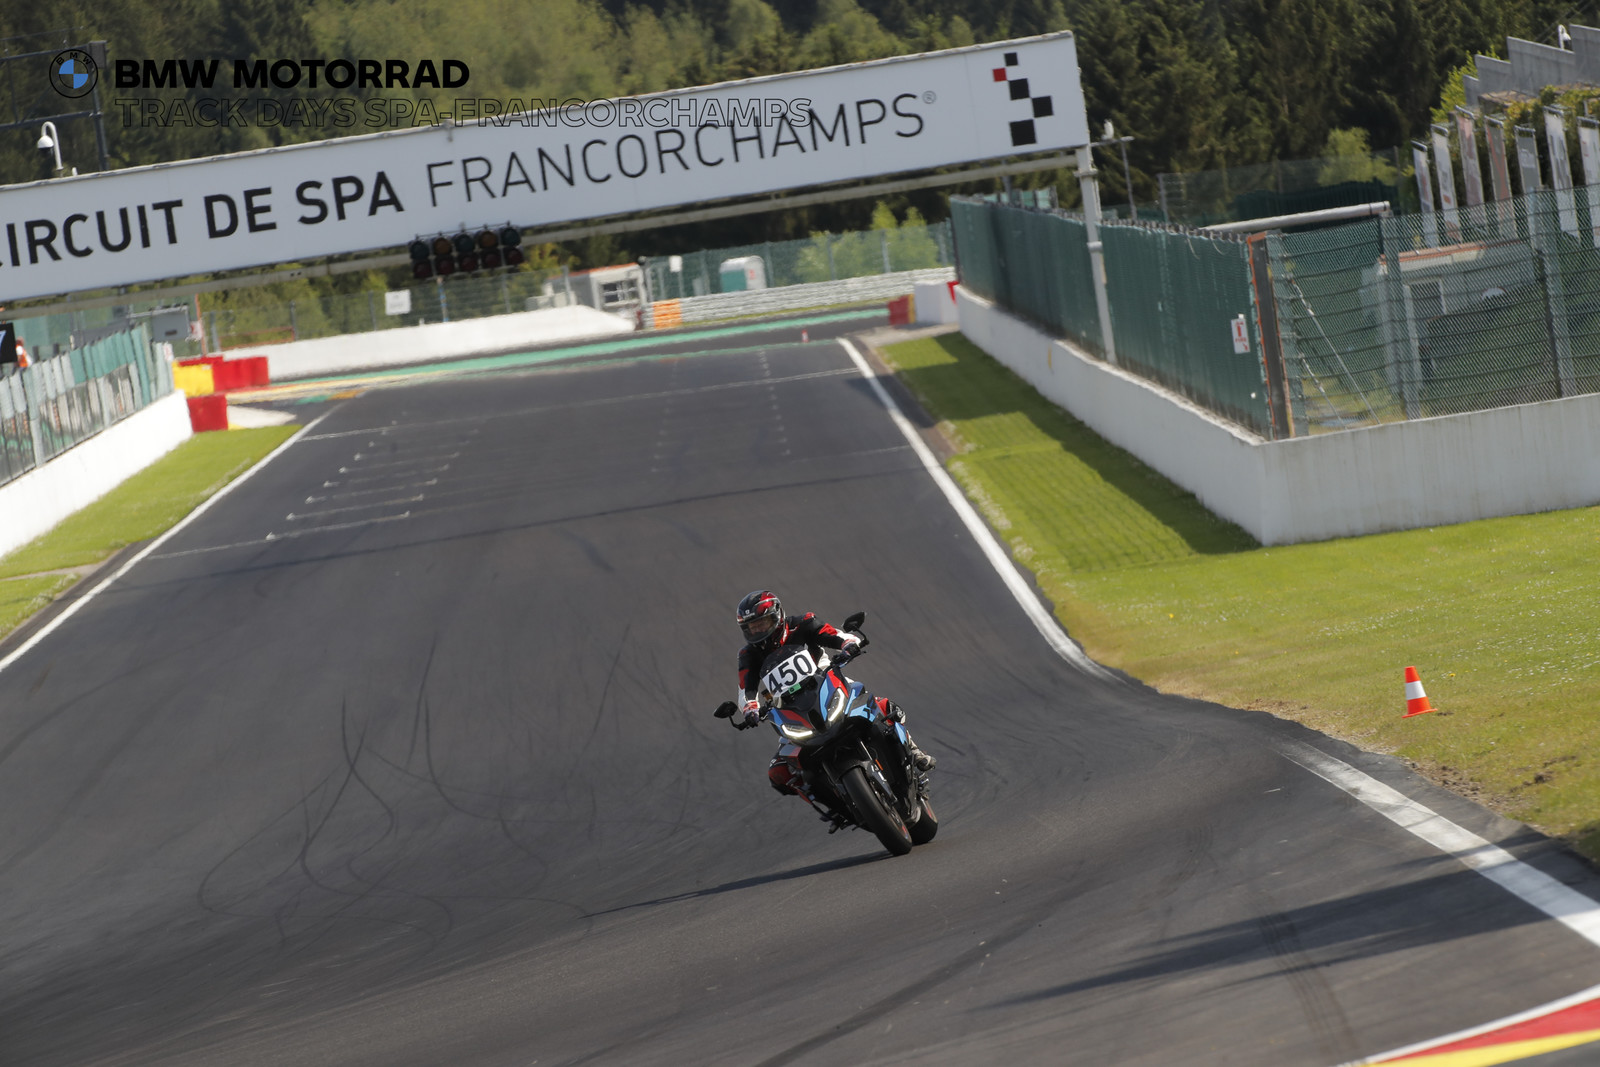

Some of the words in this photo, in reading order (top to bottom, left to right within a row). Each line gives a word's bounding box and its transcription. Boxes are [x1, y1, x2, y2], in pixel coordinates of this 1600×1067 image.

[0, 199, 183, 267] IRCUIT
[204, 186, 277, 239] DE
[295, 171, 404, 225] SPA
[768, 654, 813, 694] 450
